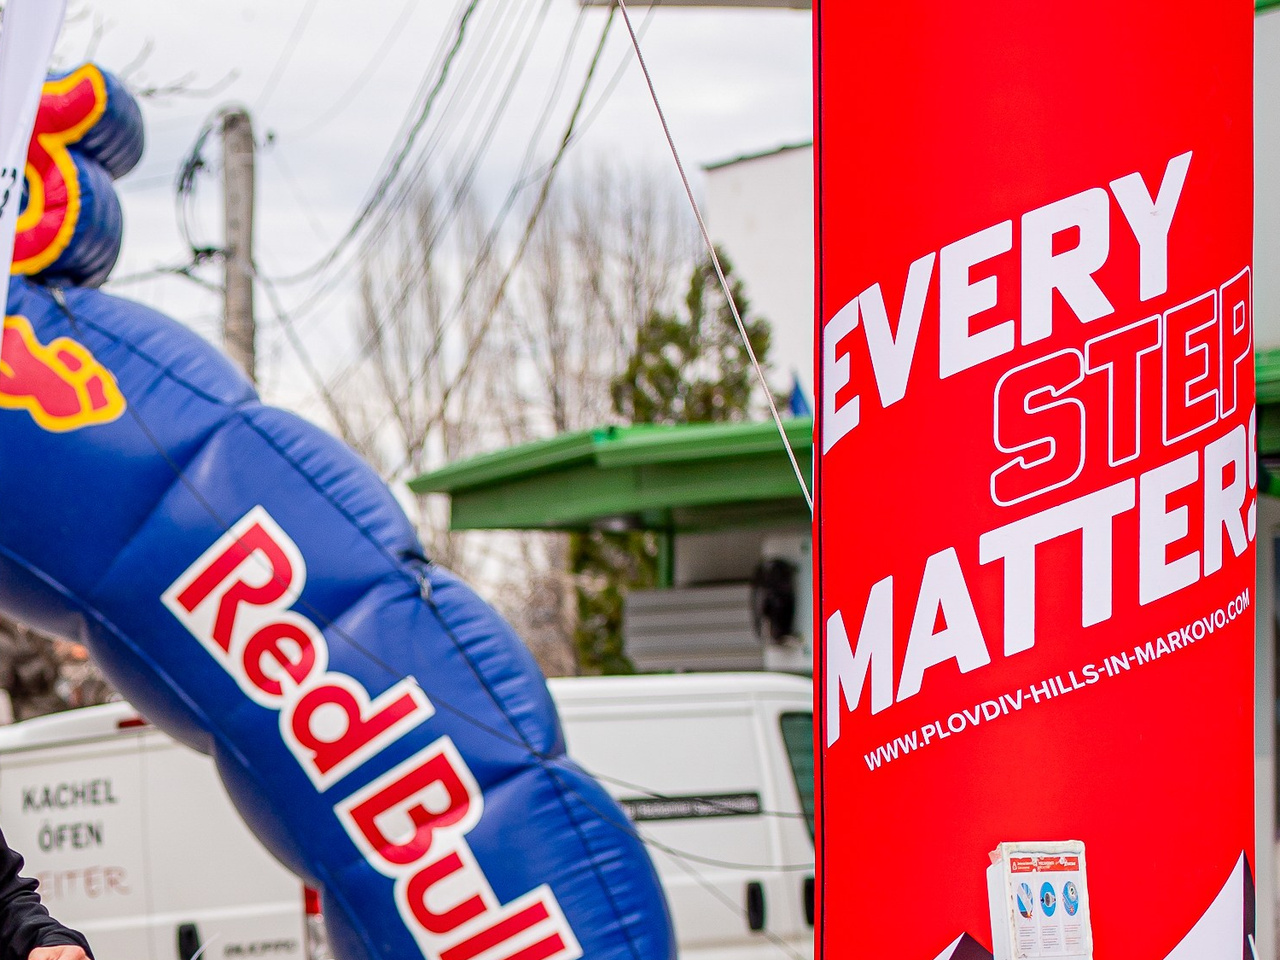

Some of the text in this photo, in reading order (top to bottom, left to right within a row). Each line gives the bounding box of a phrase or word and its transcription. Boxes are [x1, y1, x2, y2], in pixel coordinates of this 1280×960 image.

[823, 150, 1193, 455] EVERY
[991, 265, 1252, 507] STEP
[170, 513, 426, 784] Red
[864, 588, 1250, 771] WWW.PLOVDIV-HILLS-IN-MARKOVO.COM
[22, 778, 117, 810] KACHEL
[38, 820, 103, 851] ÖFEN
